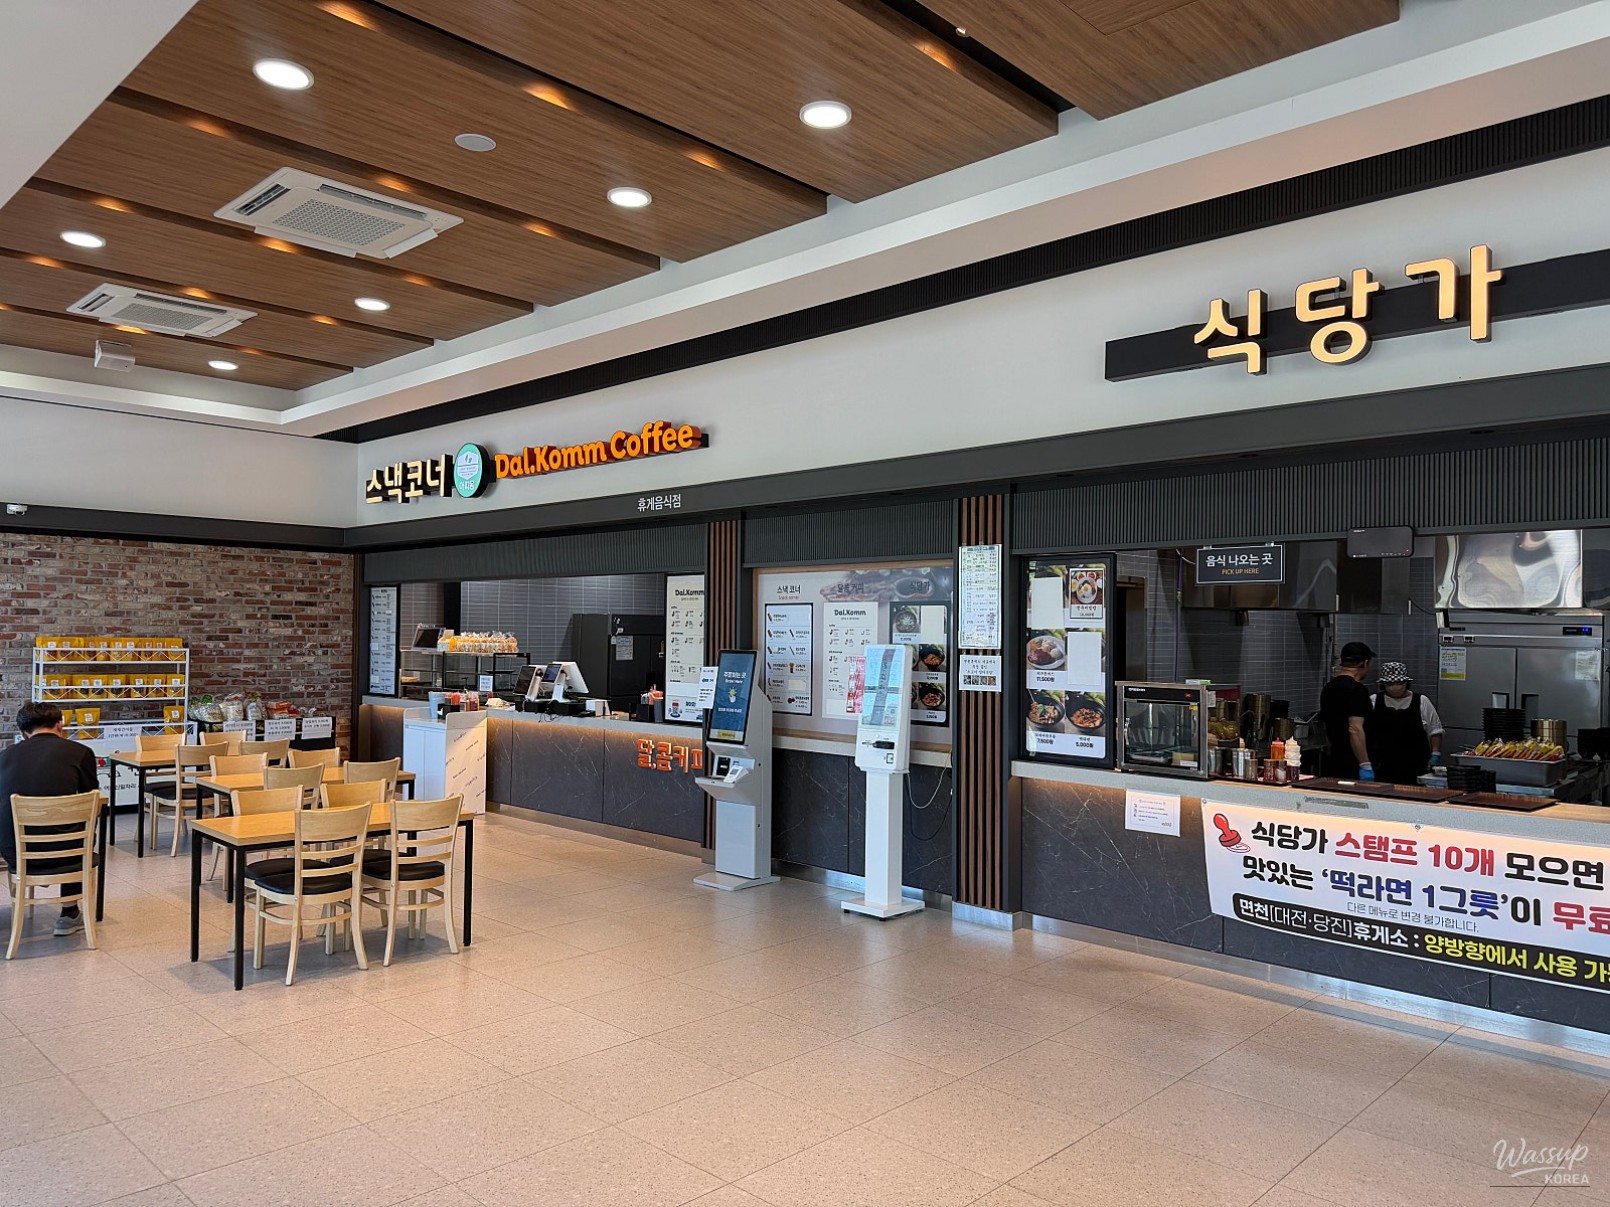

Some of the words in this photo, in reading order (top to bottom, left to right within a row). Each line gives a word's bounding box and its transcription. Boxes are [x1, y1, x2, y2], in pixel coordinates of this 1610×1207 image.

[1193, 243, 1504, 375] 식당가
[494, 440, 608, 479] Dal.Komm
[610, 419, 696, 460] Coffee
[366, 453, 447, 504] 스낵코너
[637, 493, 682, 512] 휴게음식점
[1205, 554, 1226, 567] 음식
[1228, 552, 1260, 566] 나오는
[1261, 552, 1274, 565] 곳
[789, 584, 801, 594] 코너
[1242, 855, 1314, 891] 맛있는
[1251, 821, 1328, 854] 식당가
[1334, 832, 1418, 866] 스탬프
[1428, 843, 1495, 877] 10개
[1504, 852, 1605, 891] 모으면
[1347, 901, 1367, 915] 다른
[1368, 905, 1398, 920] 메뉴로
[1401, 911, 1422, 924] 변경
[1423, 914, 1480, 934] 불가합니다.
[1424, 933, 1528, 970] 양방향에서
[1533, 952, 1578, 979] 사용
